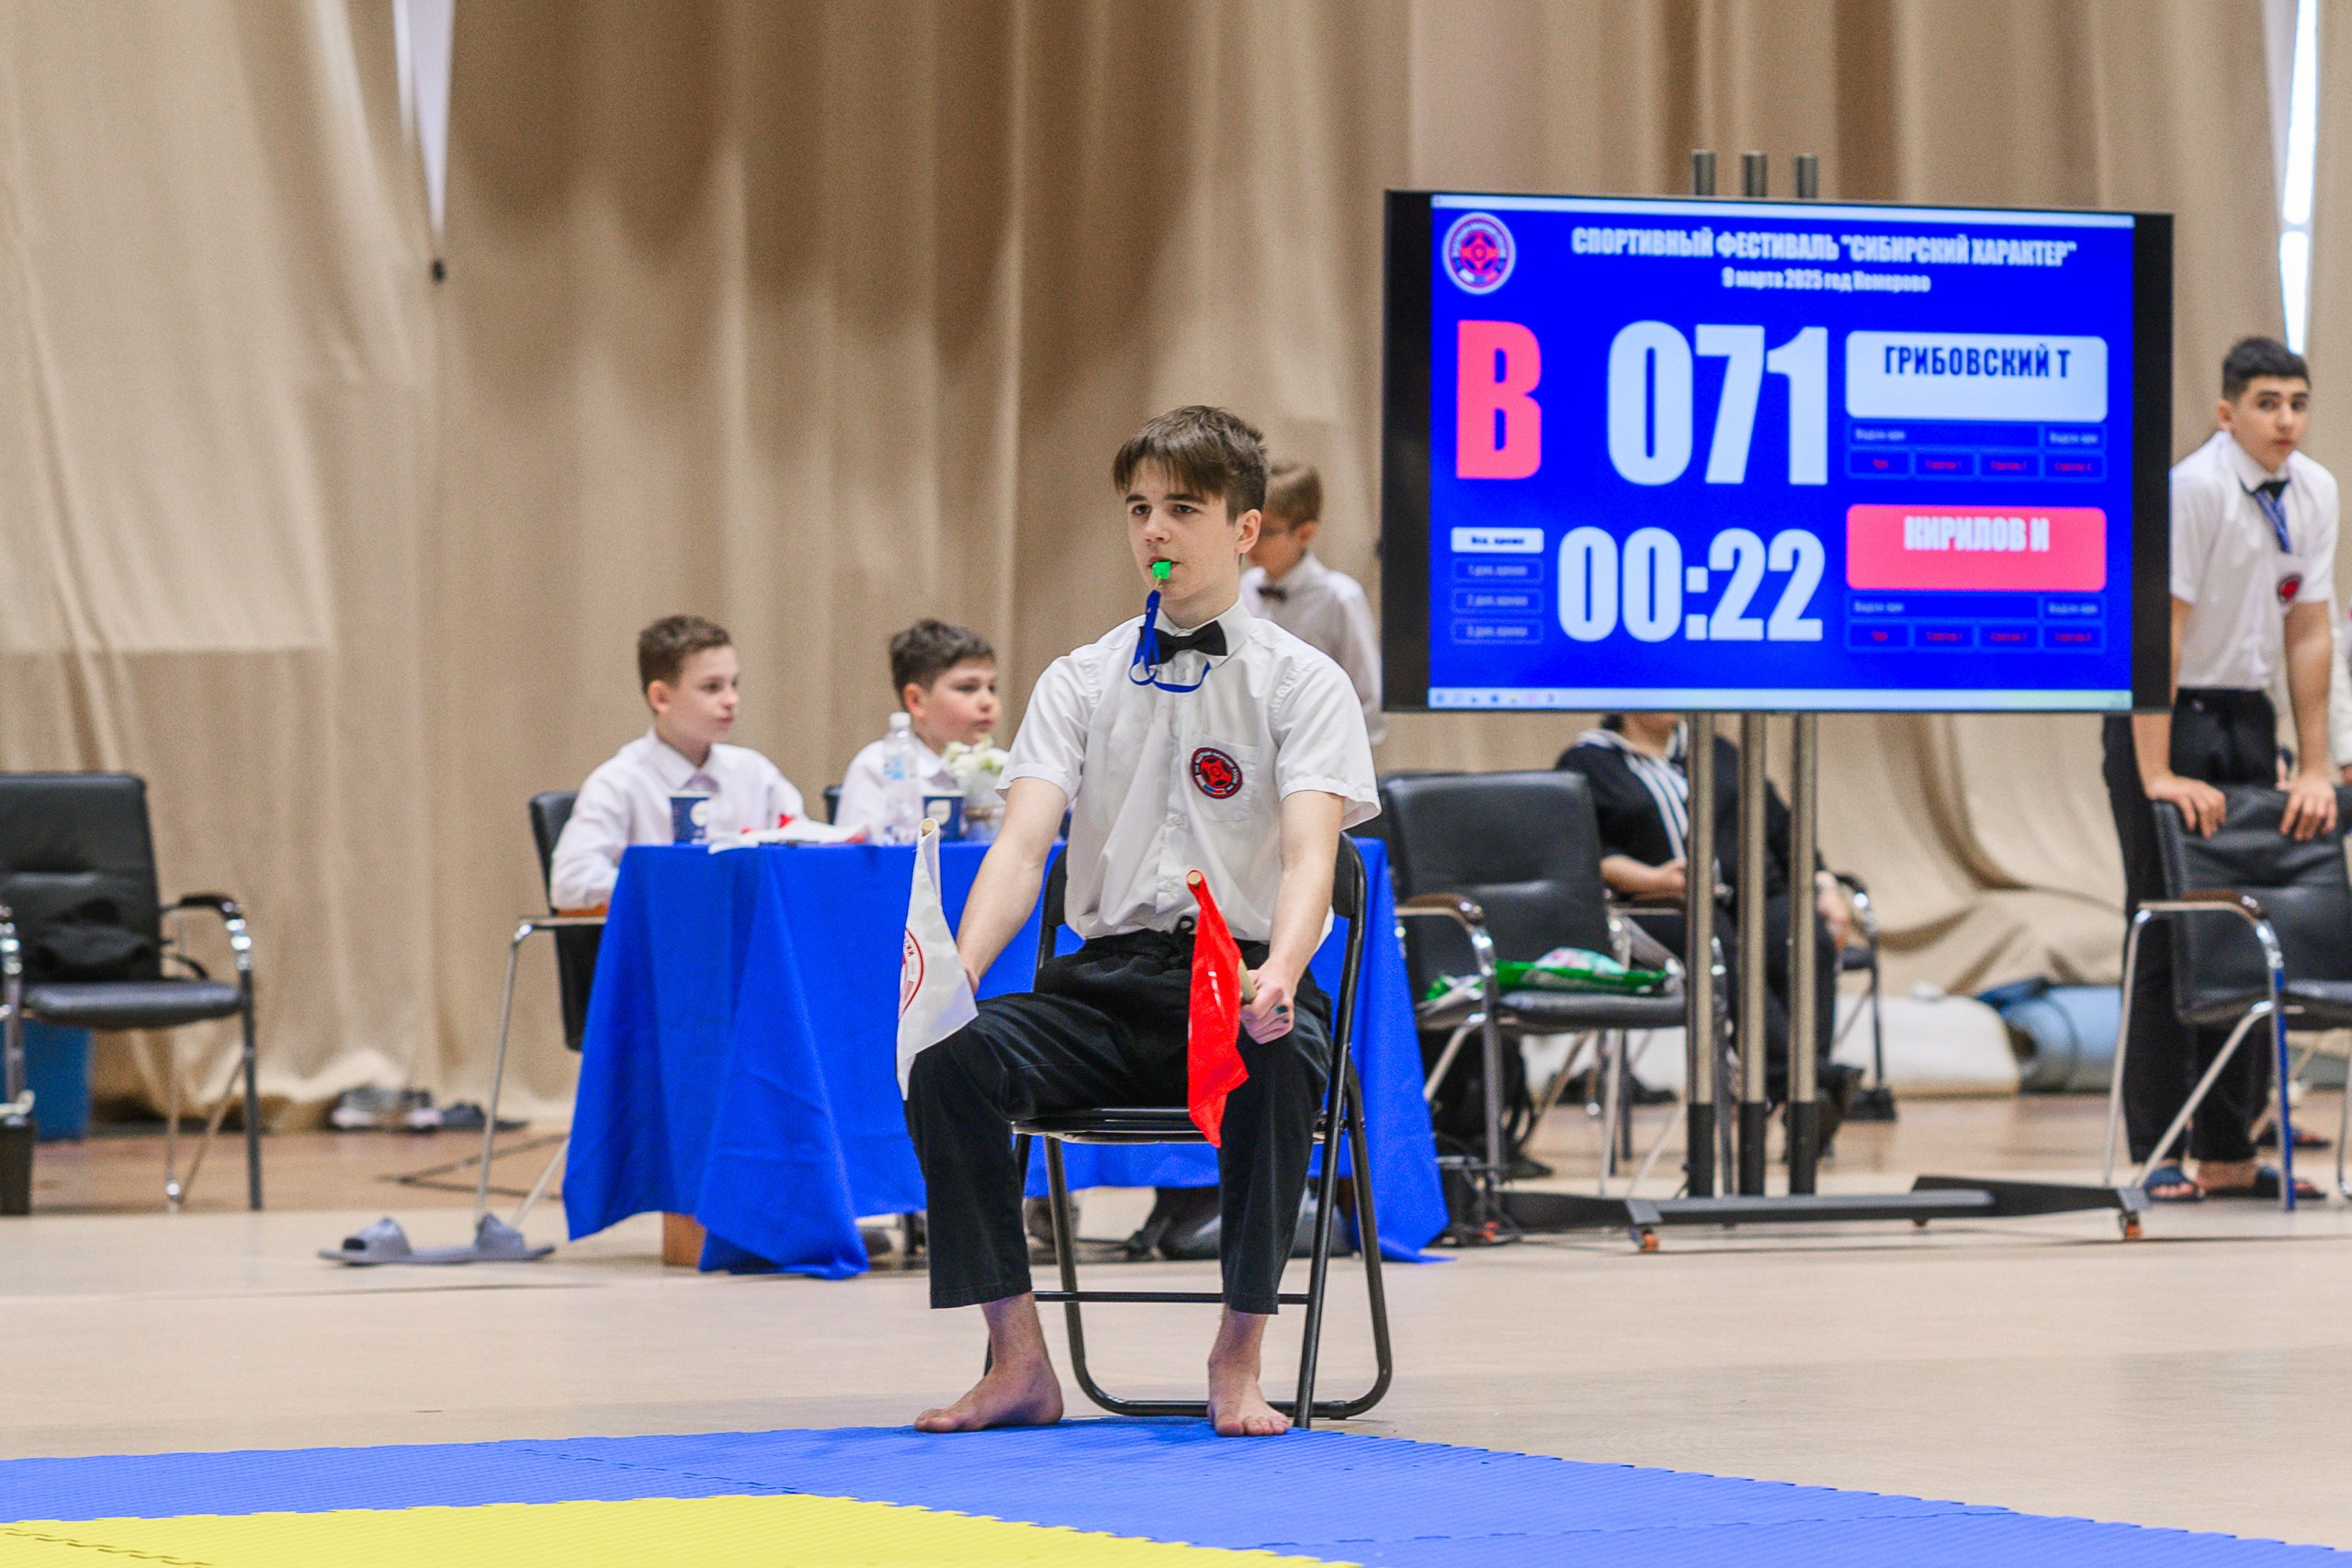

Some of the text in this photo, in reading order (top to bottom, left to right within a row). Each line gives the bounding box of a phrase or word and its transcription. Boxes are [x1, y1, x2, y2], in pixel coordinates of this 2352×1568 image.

[1572, 227, 1713, 257] СПОРТИВНЫЙ
[1715, 231, 1839, 261] ФЕСТИВАЛЬ
[1722, 266, 1735, 288] 9
[1784, 267, 1823, 290] 2025
[1884, 344, 2050, 378] ГРИБОВСКИЙ
[1608, 321, 1827, 485] 071
[1557, 526, 1825, 642] 00:22
